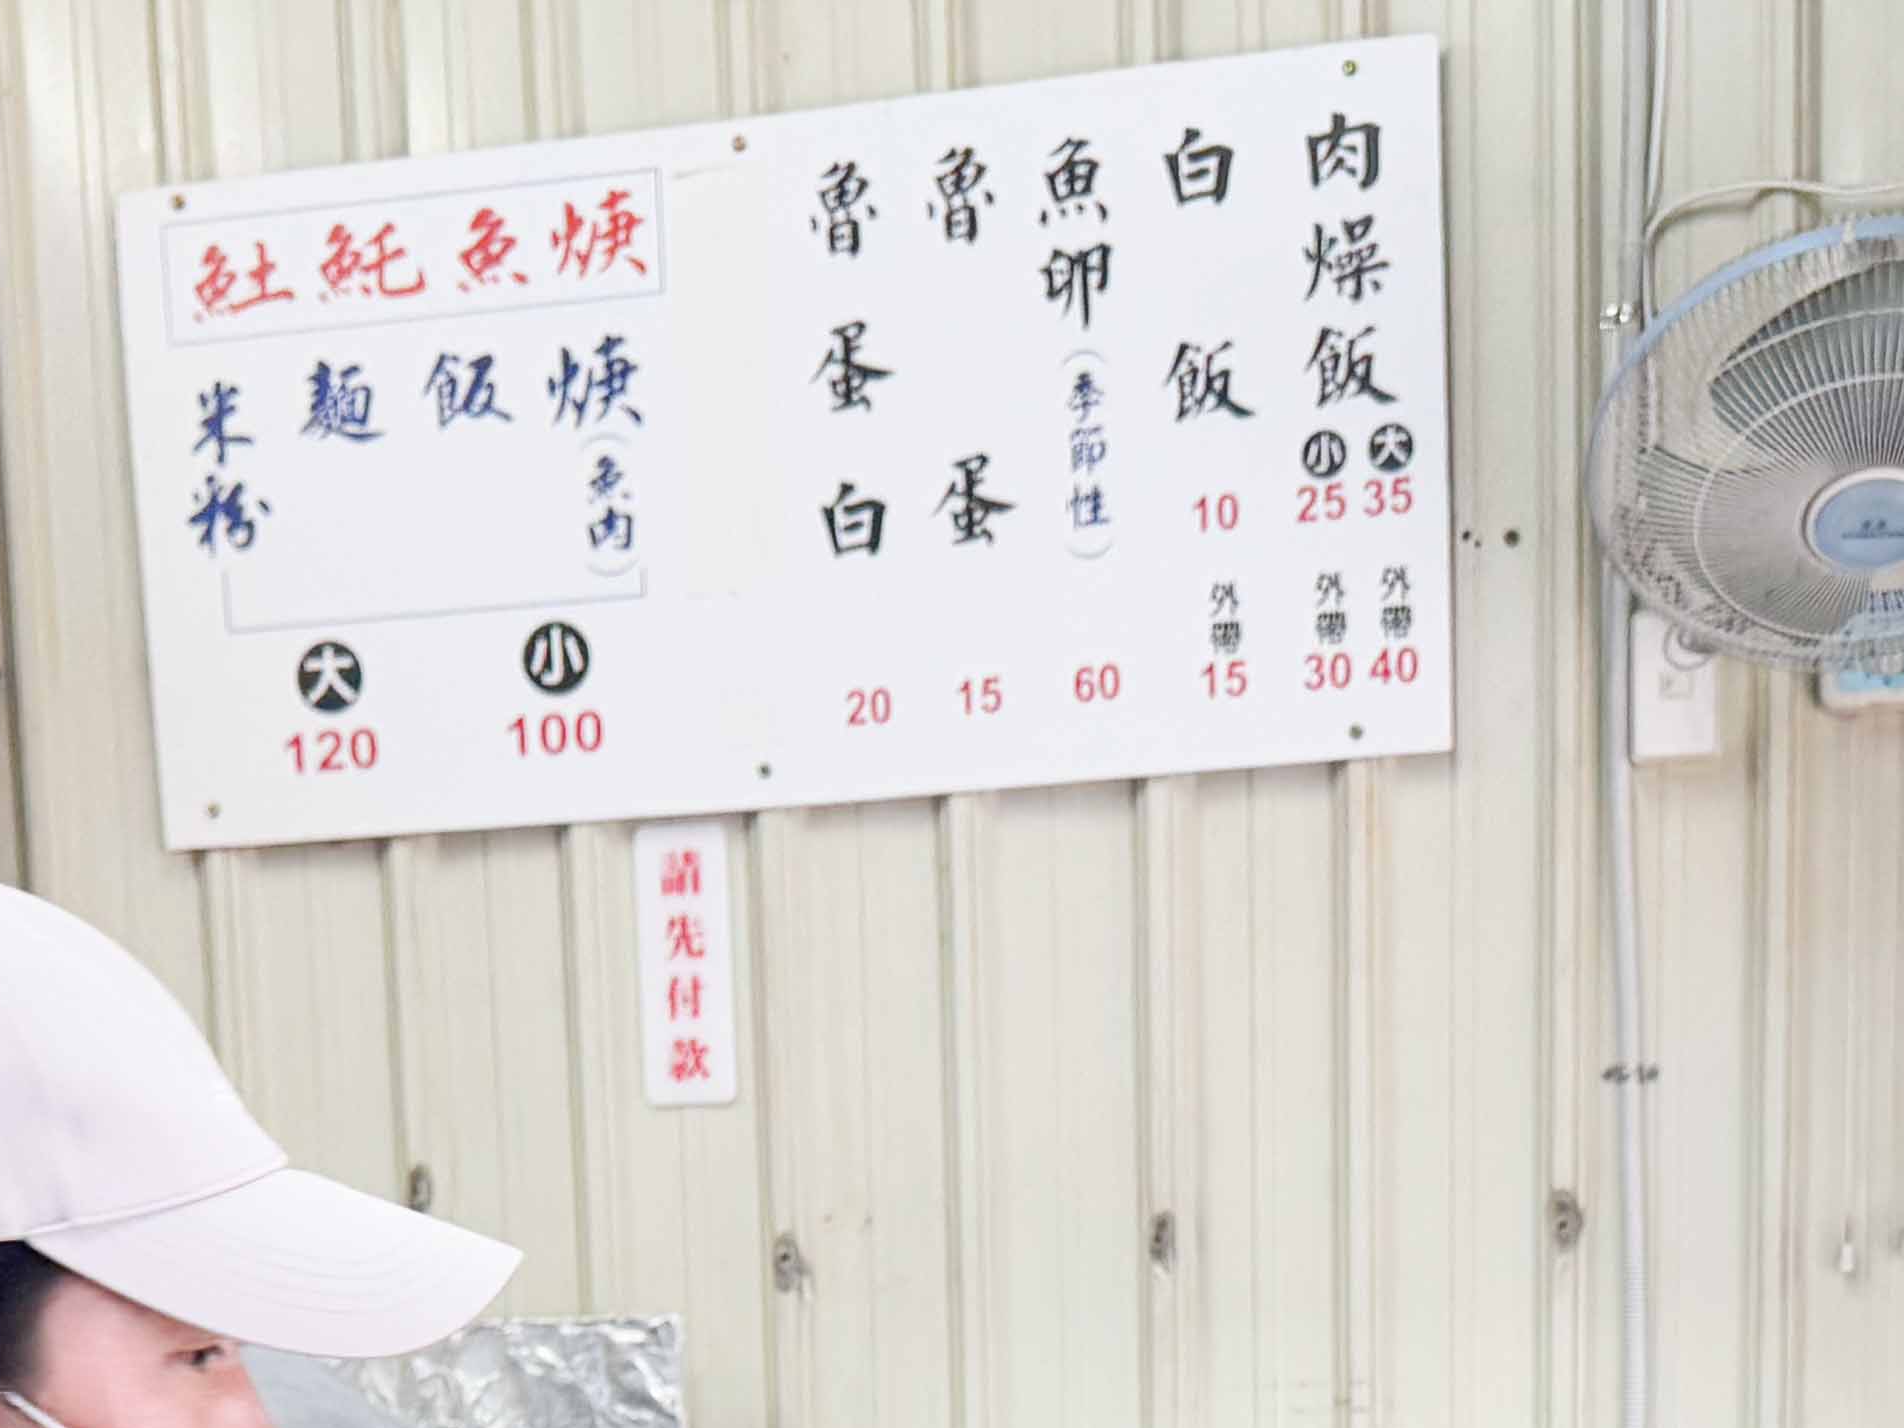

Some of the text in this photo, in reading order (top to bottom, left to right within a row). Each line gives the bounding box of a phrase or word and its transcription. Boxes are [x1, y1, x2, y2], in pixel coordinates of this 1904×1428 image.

[425, 352, 514, 428] 飯
[187, 380, 272, 553] 米粉
[1193, 493, 1239, 532] 10
[1296, 482, 1346, 523] 25
[1363, 475, 1414, 517] 35
[300, 644, 359, 710] 大
[526, 625, 588, 693] 小
[1202, 659, 1248, 698] 15
[1304, 652, 1352, 691] 30
[1369, 647, 1419, 684] 40
[960, 676, 1003, 715] 15
[1074, 663, 1121, 703] 60
[847, 687, 892, 726] 20
[287, 727, 379, 773] 120
[508, 710, 604, 757] 100
[661, 849, 711, 1083] 請先付款
